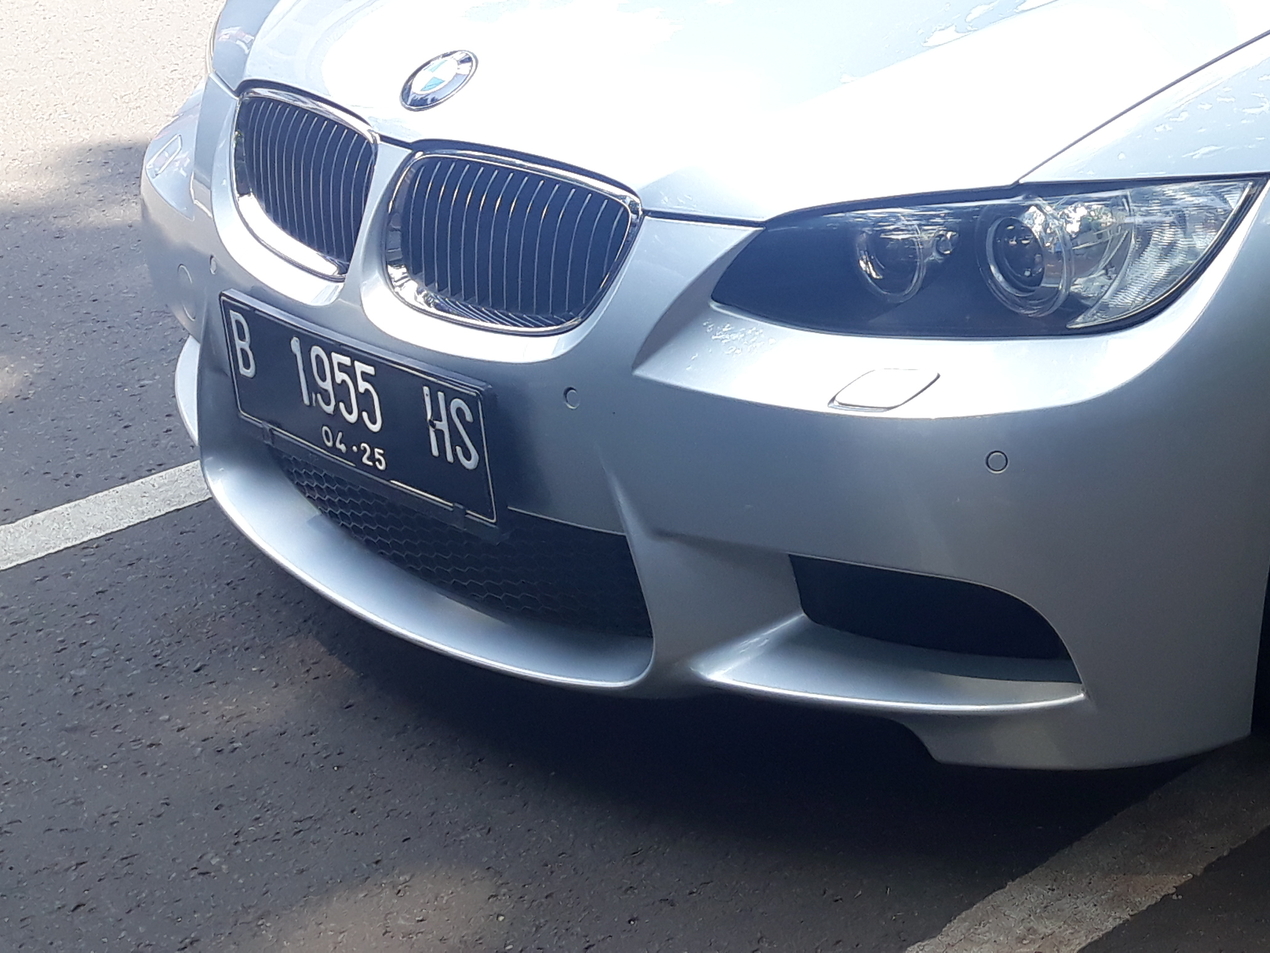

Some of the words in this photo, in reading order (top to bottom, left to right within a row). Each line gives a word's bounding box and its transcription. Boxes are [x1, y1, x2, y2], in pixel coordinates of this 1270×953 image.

[229, 310, 256, 378] B
[290, 336, 383, 433] 1955
[422, 385, 479, 470] HS
